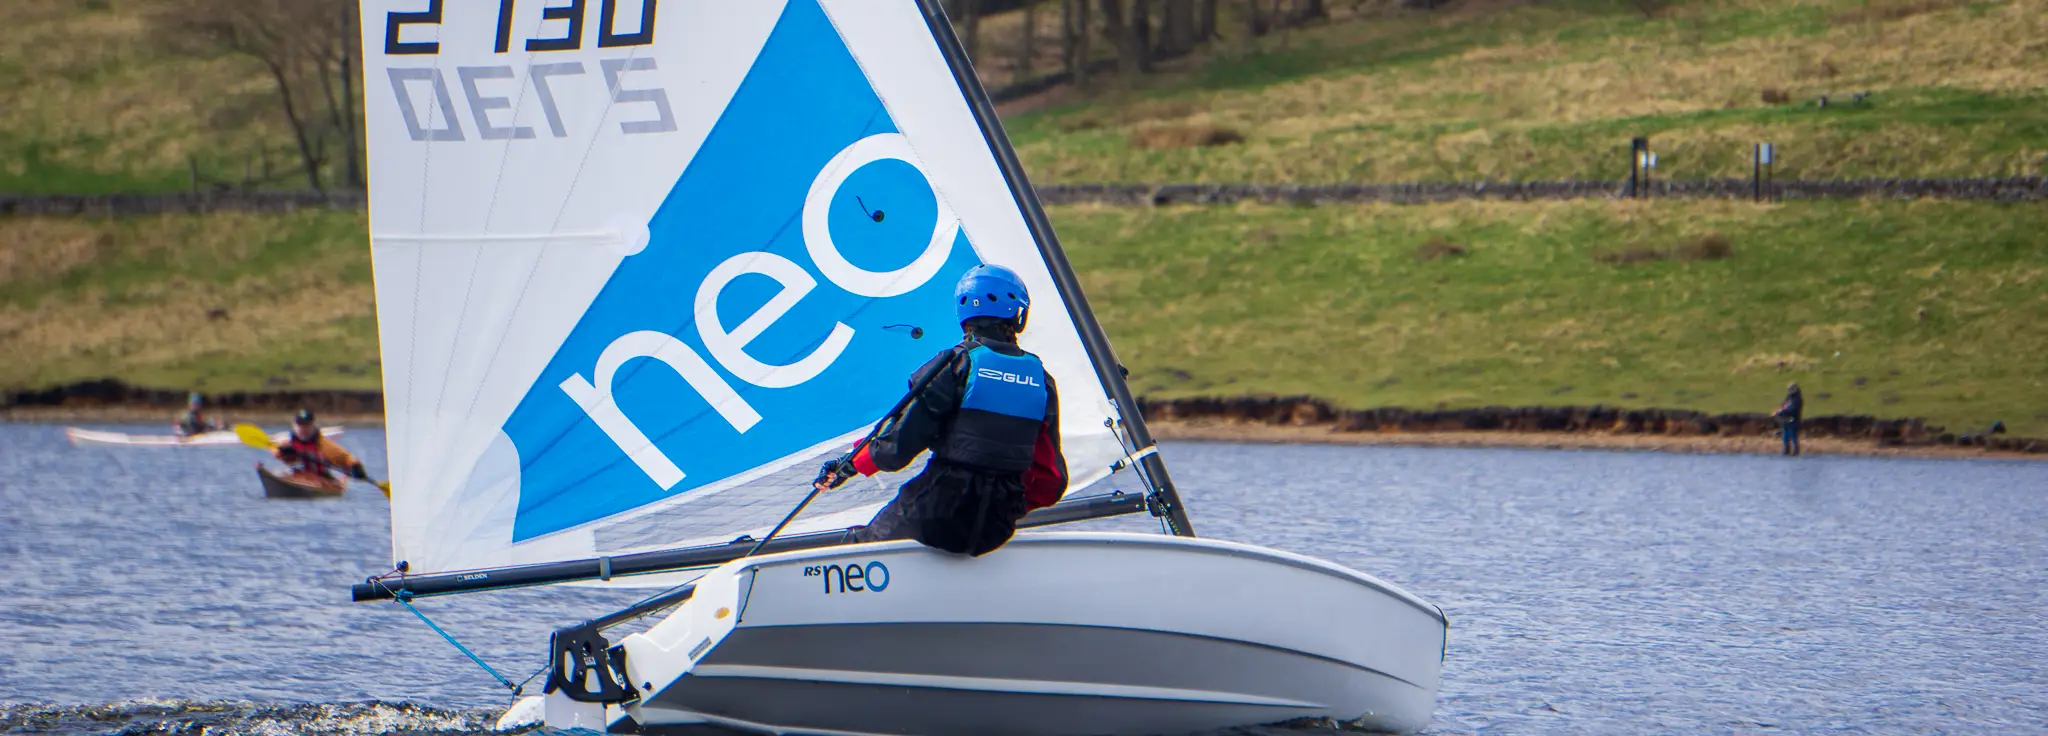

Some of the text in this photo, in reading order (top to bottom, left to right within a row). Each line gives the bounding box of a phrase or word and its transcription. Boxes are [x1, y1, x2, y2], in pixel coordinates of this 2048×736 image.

[558, 132, 960, 492] neo
[1002, 372, 1040, 387] GUL
[803, 560, 890, 595] RS neo
